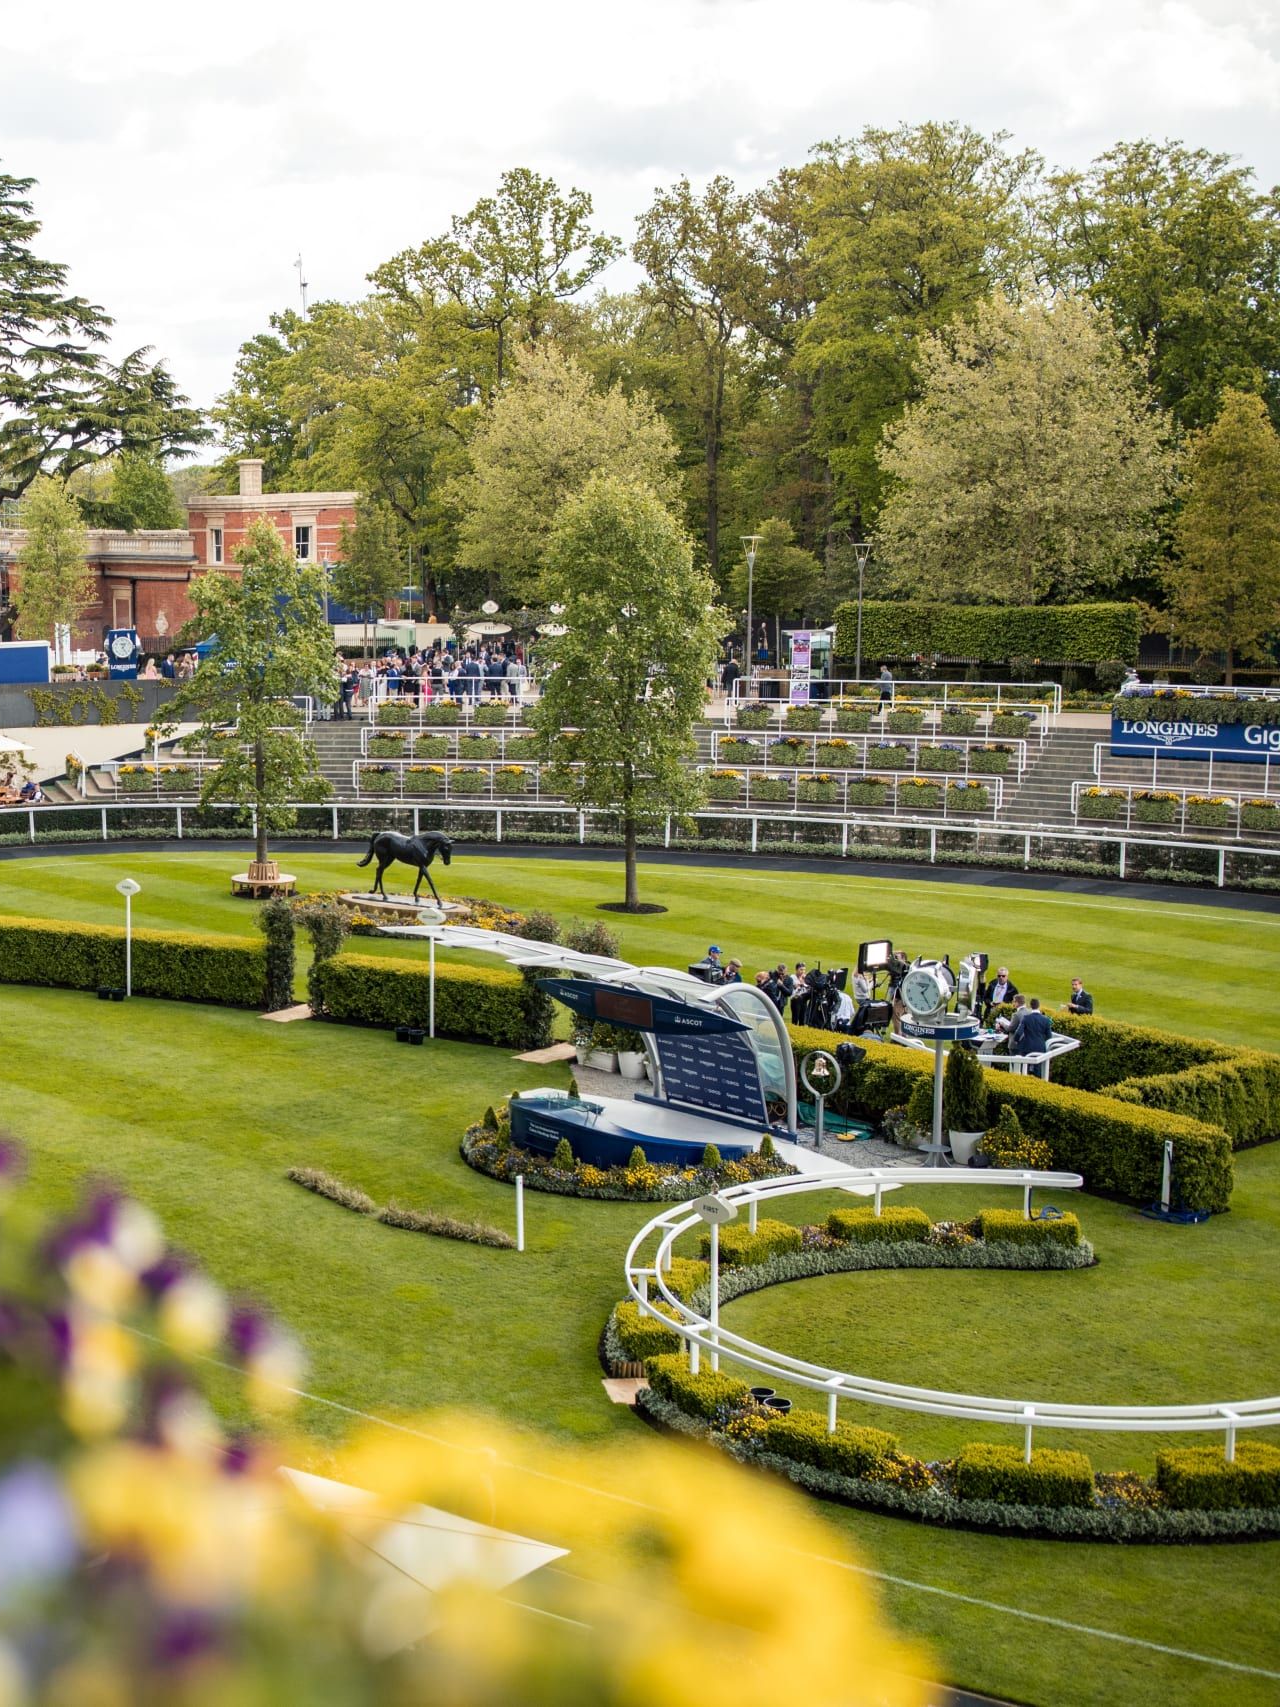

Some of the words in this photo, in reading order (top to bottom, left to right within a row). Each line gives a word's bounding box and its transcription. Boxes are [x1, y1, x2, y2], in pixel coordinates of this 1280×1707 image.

[1121, 720, 1218, 737] LONGINES
[564, 991, 579, 1000] ASCOT
[681, 1018, 703, 1027] ASCOT
[903, 1023, 936, 1035] LONGINES
[703, 1204, 719, 1214] FIRST
